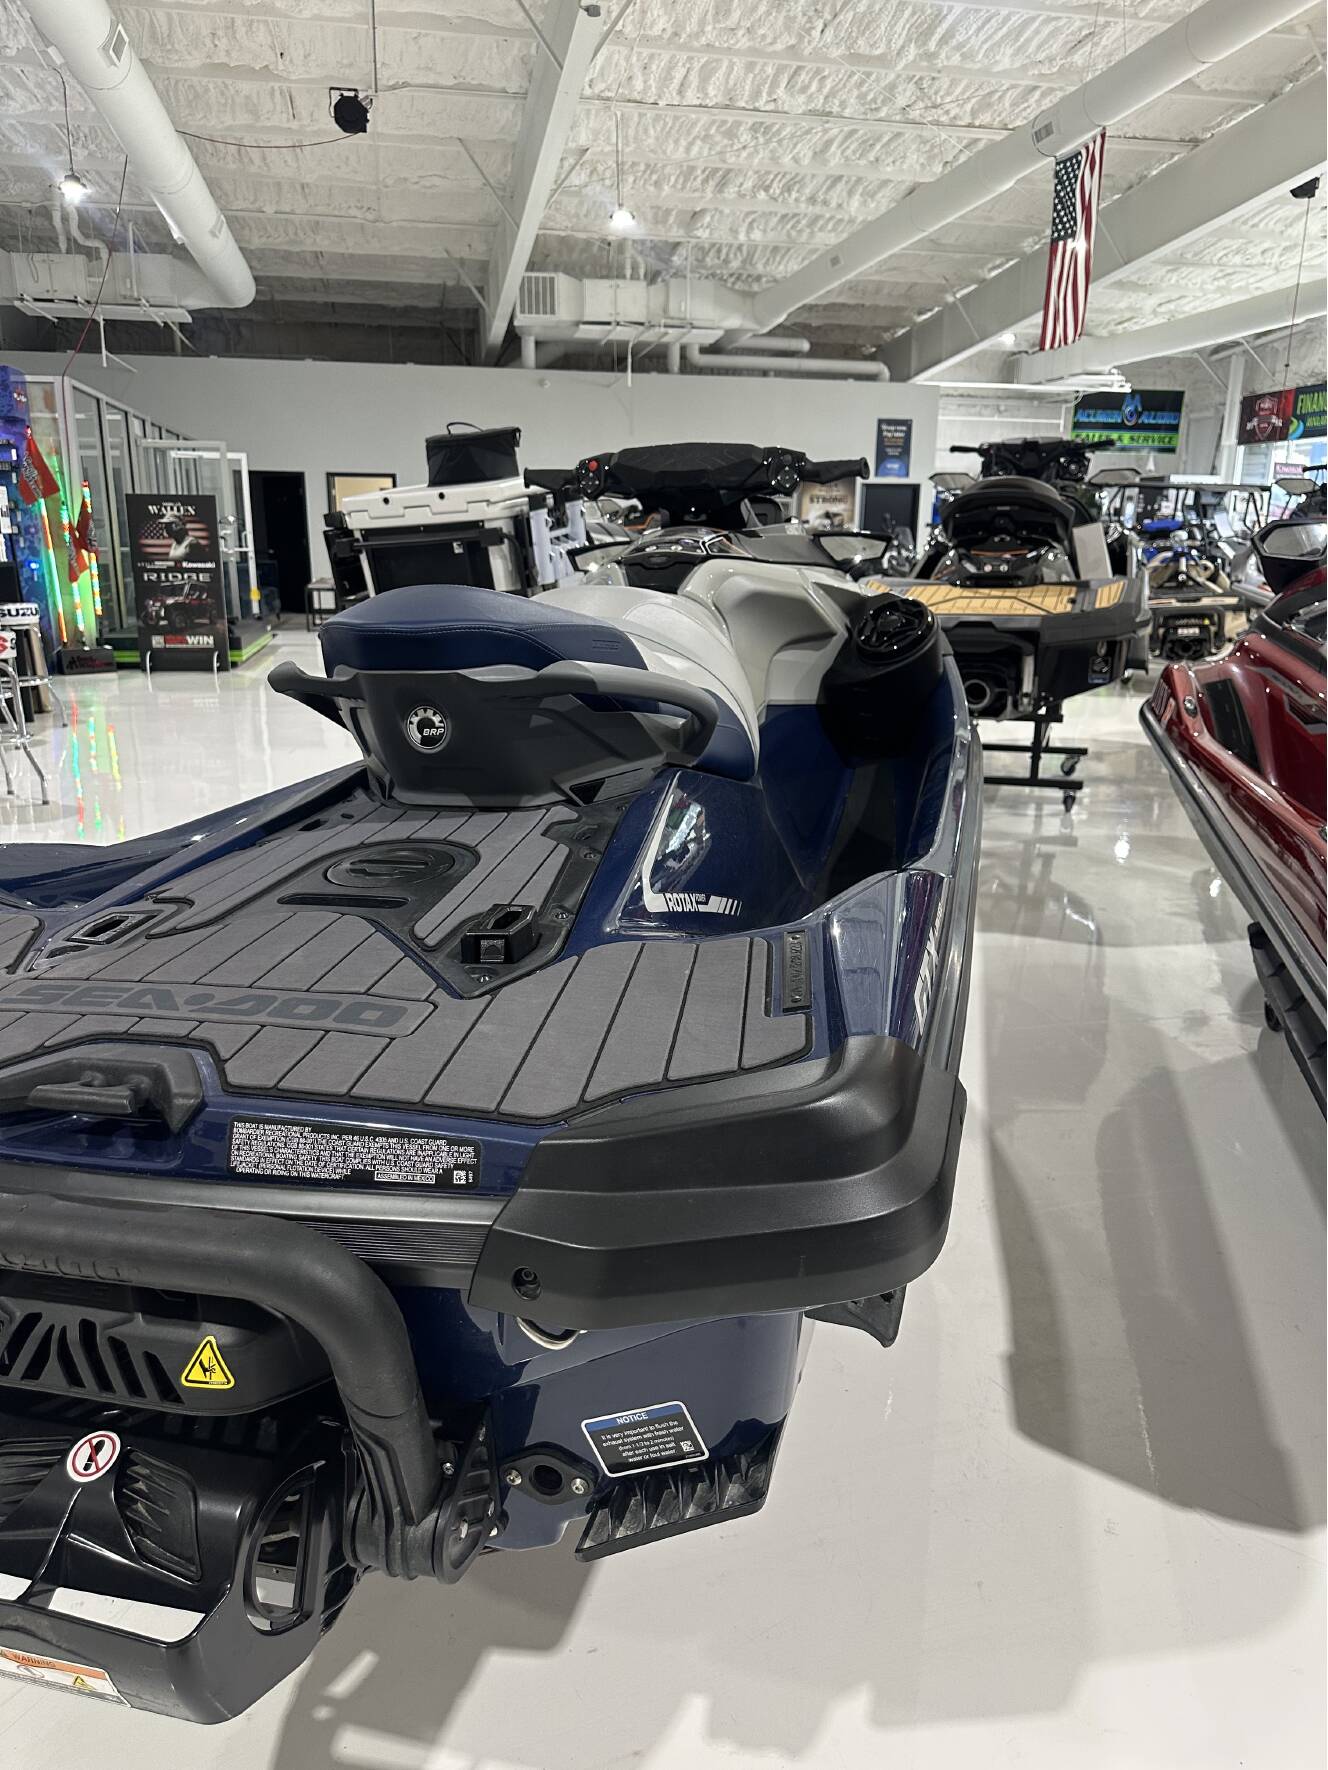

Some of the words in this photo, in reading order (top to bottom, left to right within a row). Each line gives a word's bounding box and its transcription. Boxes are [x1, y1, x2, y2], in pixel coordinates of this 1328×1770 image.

[143, 572, 211, 582] RIDGE
[186, 635, 214, 645] WIN
[423, 728, 445, 736] BRP
[664, 893, 699, 912] ROTAX
[616, 1412, 649, 1424] NOTICE
[12, 1653, 56, 1668] WARNING
